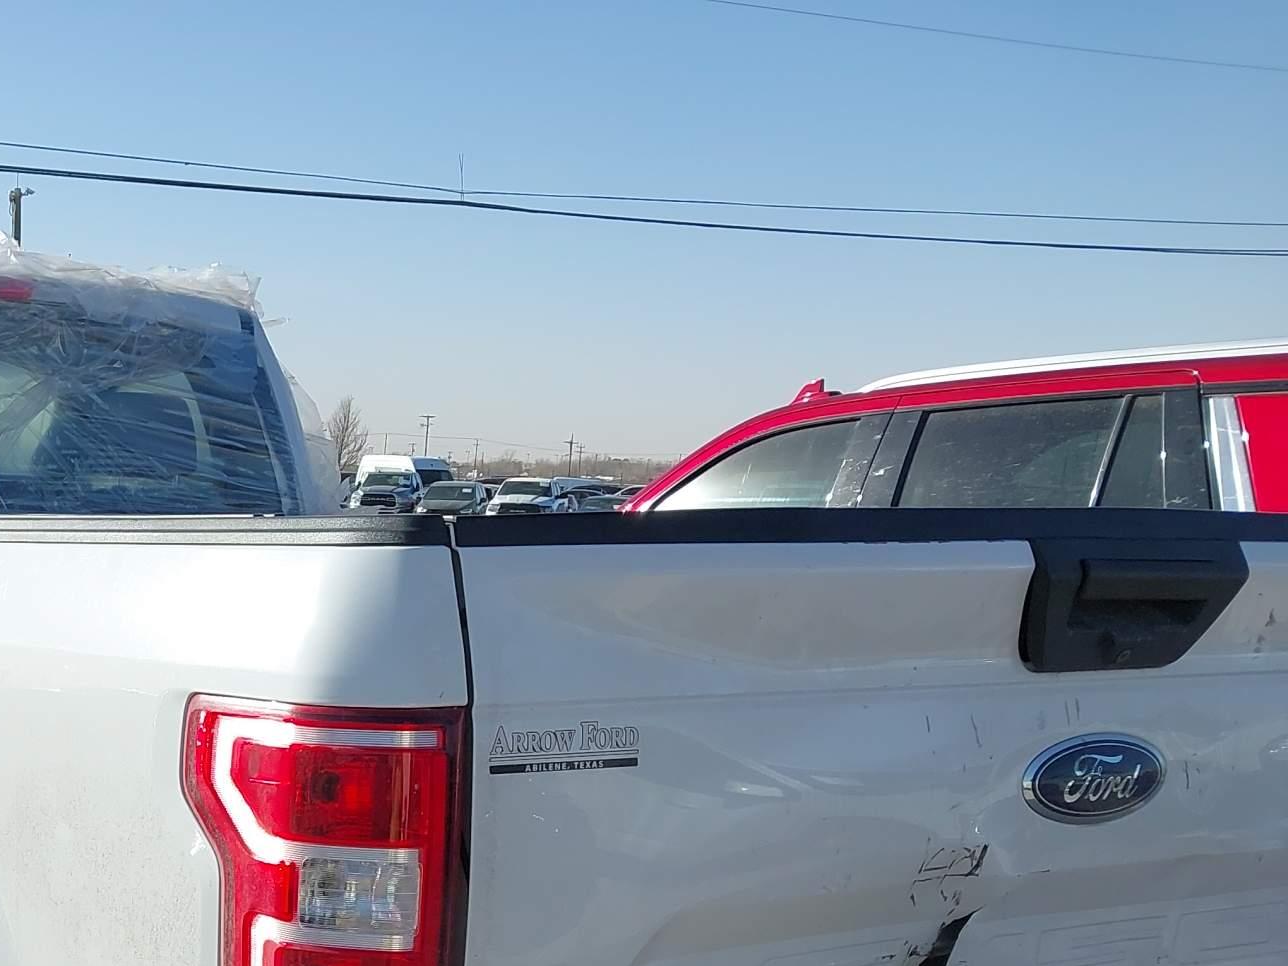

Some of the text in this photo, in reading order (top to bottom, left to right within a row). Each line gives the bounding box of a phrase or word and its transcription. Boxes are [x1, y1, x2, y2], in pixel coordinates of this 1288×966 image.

[489, 720, 640, 756] ARROW FORD
[524, 760, 605, 774] ABILENE, TEXAS
[1063, 753, 1142, 804] Ford
